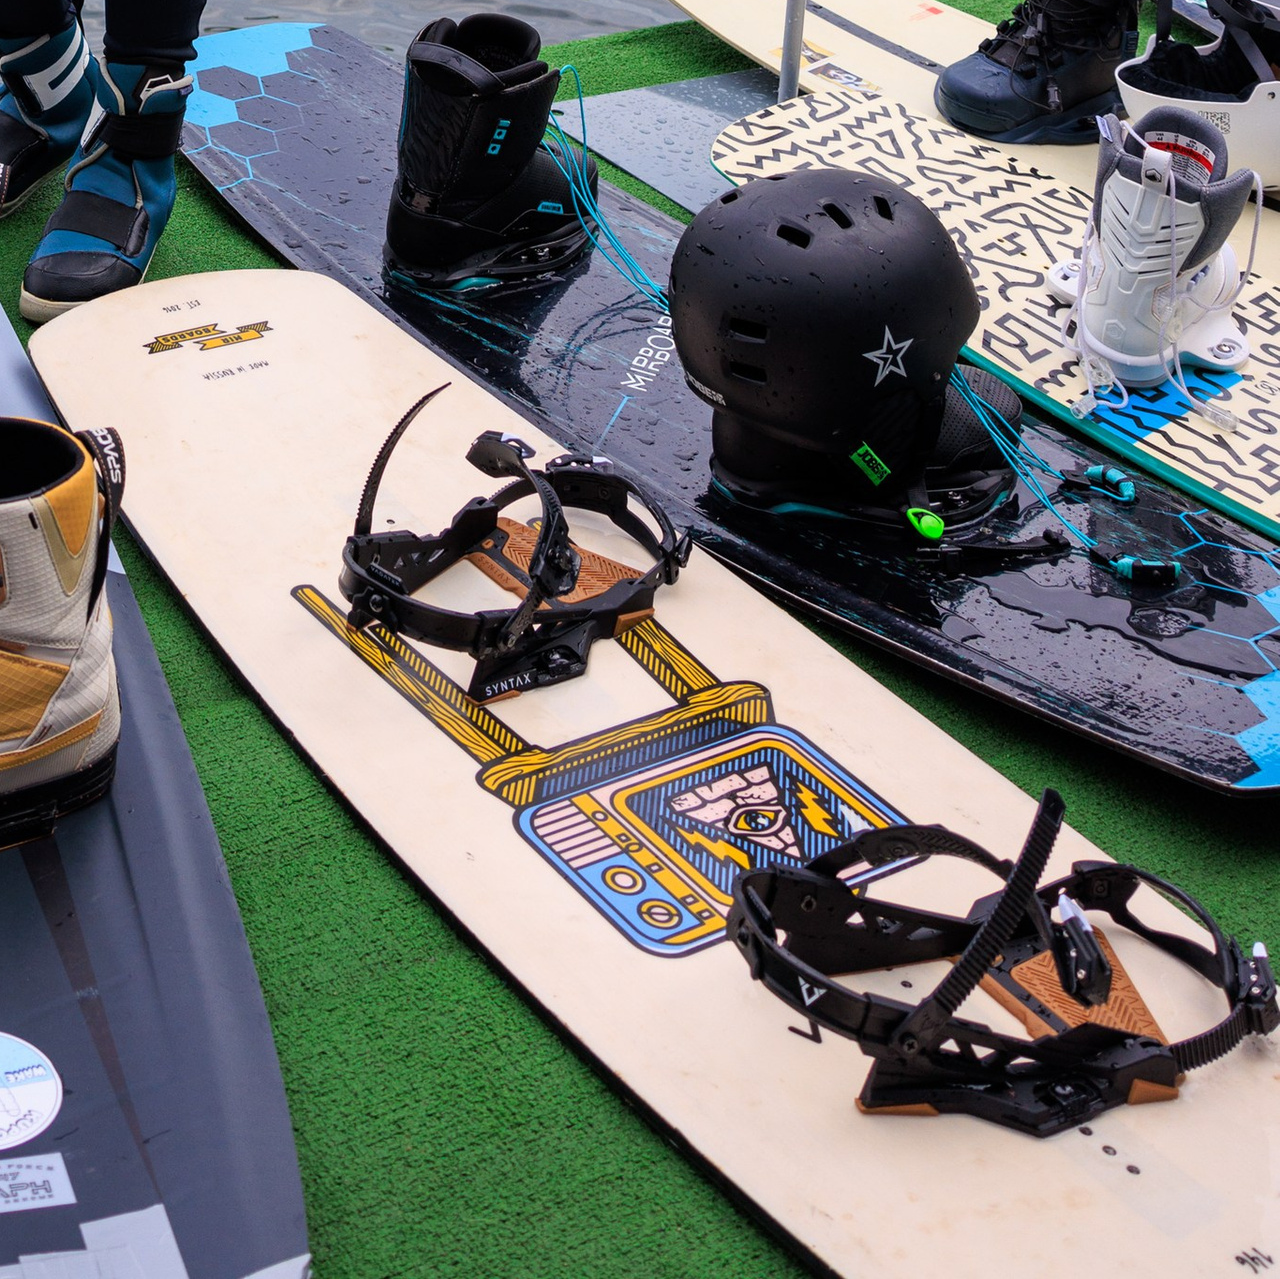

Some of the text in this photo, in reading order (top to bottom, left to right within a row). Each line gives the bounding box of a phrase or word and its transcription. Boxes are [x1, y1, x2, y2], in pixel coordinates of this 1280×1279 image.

[161, 326, 212, 344] BOARDS
[220, 334, 243, 345] MIR
[485, 672, 532, 697] SYNTAX
[3, 1063, 48, 1084] WAKE
